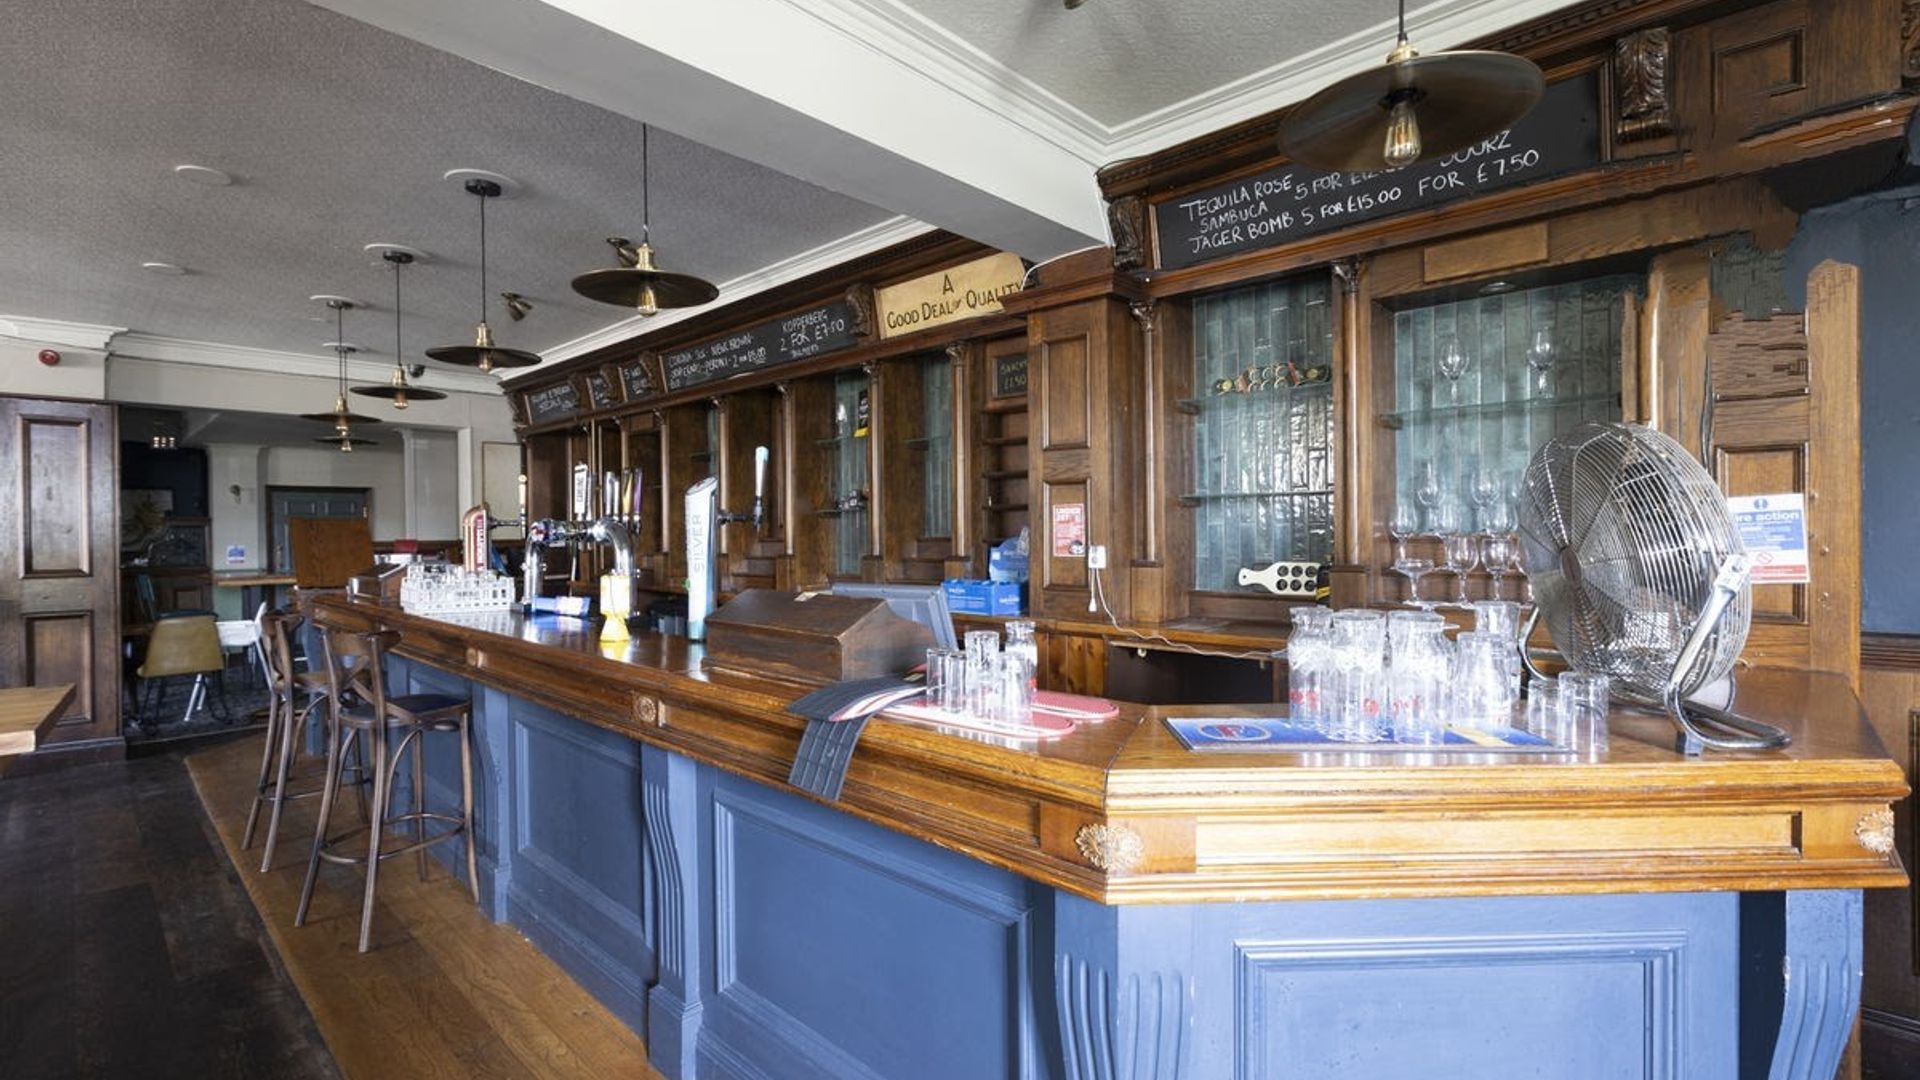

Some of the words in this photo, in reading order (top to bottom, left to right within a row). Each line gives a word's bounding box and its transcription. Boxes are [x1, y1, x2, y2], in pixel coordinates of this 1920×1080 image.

[1179, 186, 1251, 222] TEQUILA
[1254, 174, 1293, 199] ROSE
[1294, 183, 1309, 201] 5
[1312, 171, 1343, 194] FOR
[1418, 171, 1465, 197] FOR
[1189, 227, 1244, 254] JAGER
[1248, 211, 1294, 240] BOMB
[1301, 207, 1315, 226] 5
[1320, 202, 1344, 218] FOR
[1347, 187, 1402, 213] £15.00
[1200, 201, 1269, 234] SAMBUCA
[942, 274, 955, 295] A
[886, 308, 920, 329] GOOD
[922, 302, 953, 321] DEAL
[1755, 511, 1801, 521] action
[692, 514, 705, 574] SILVER
